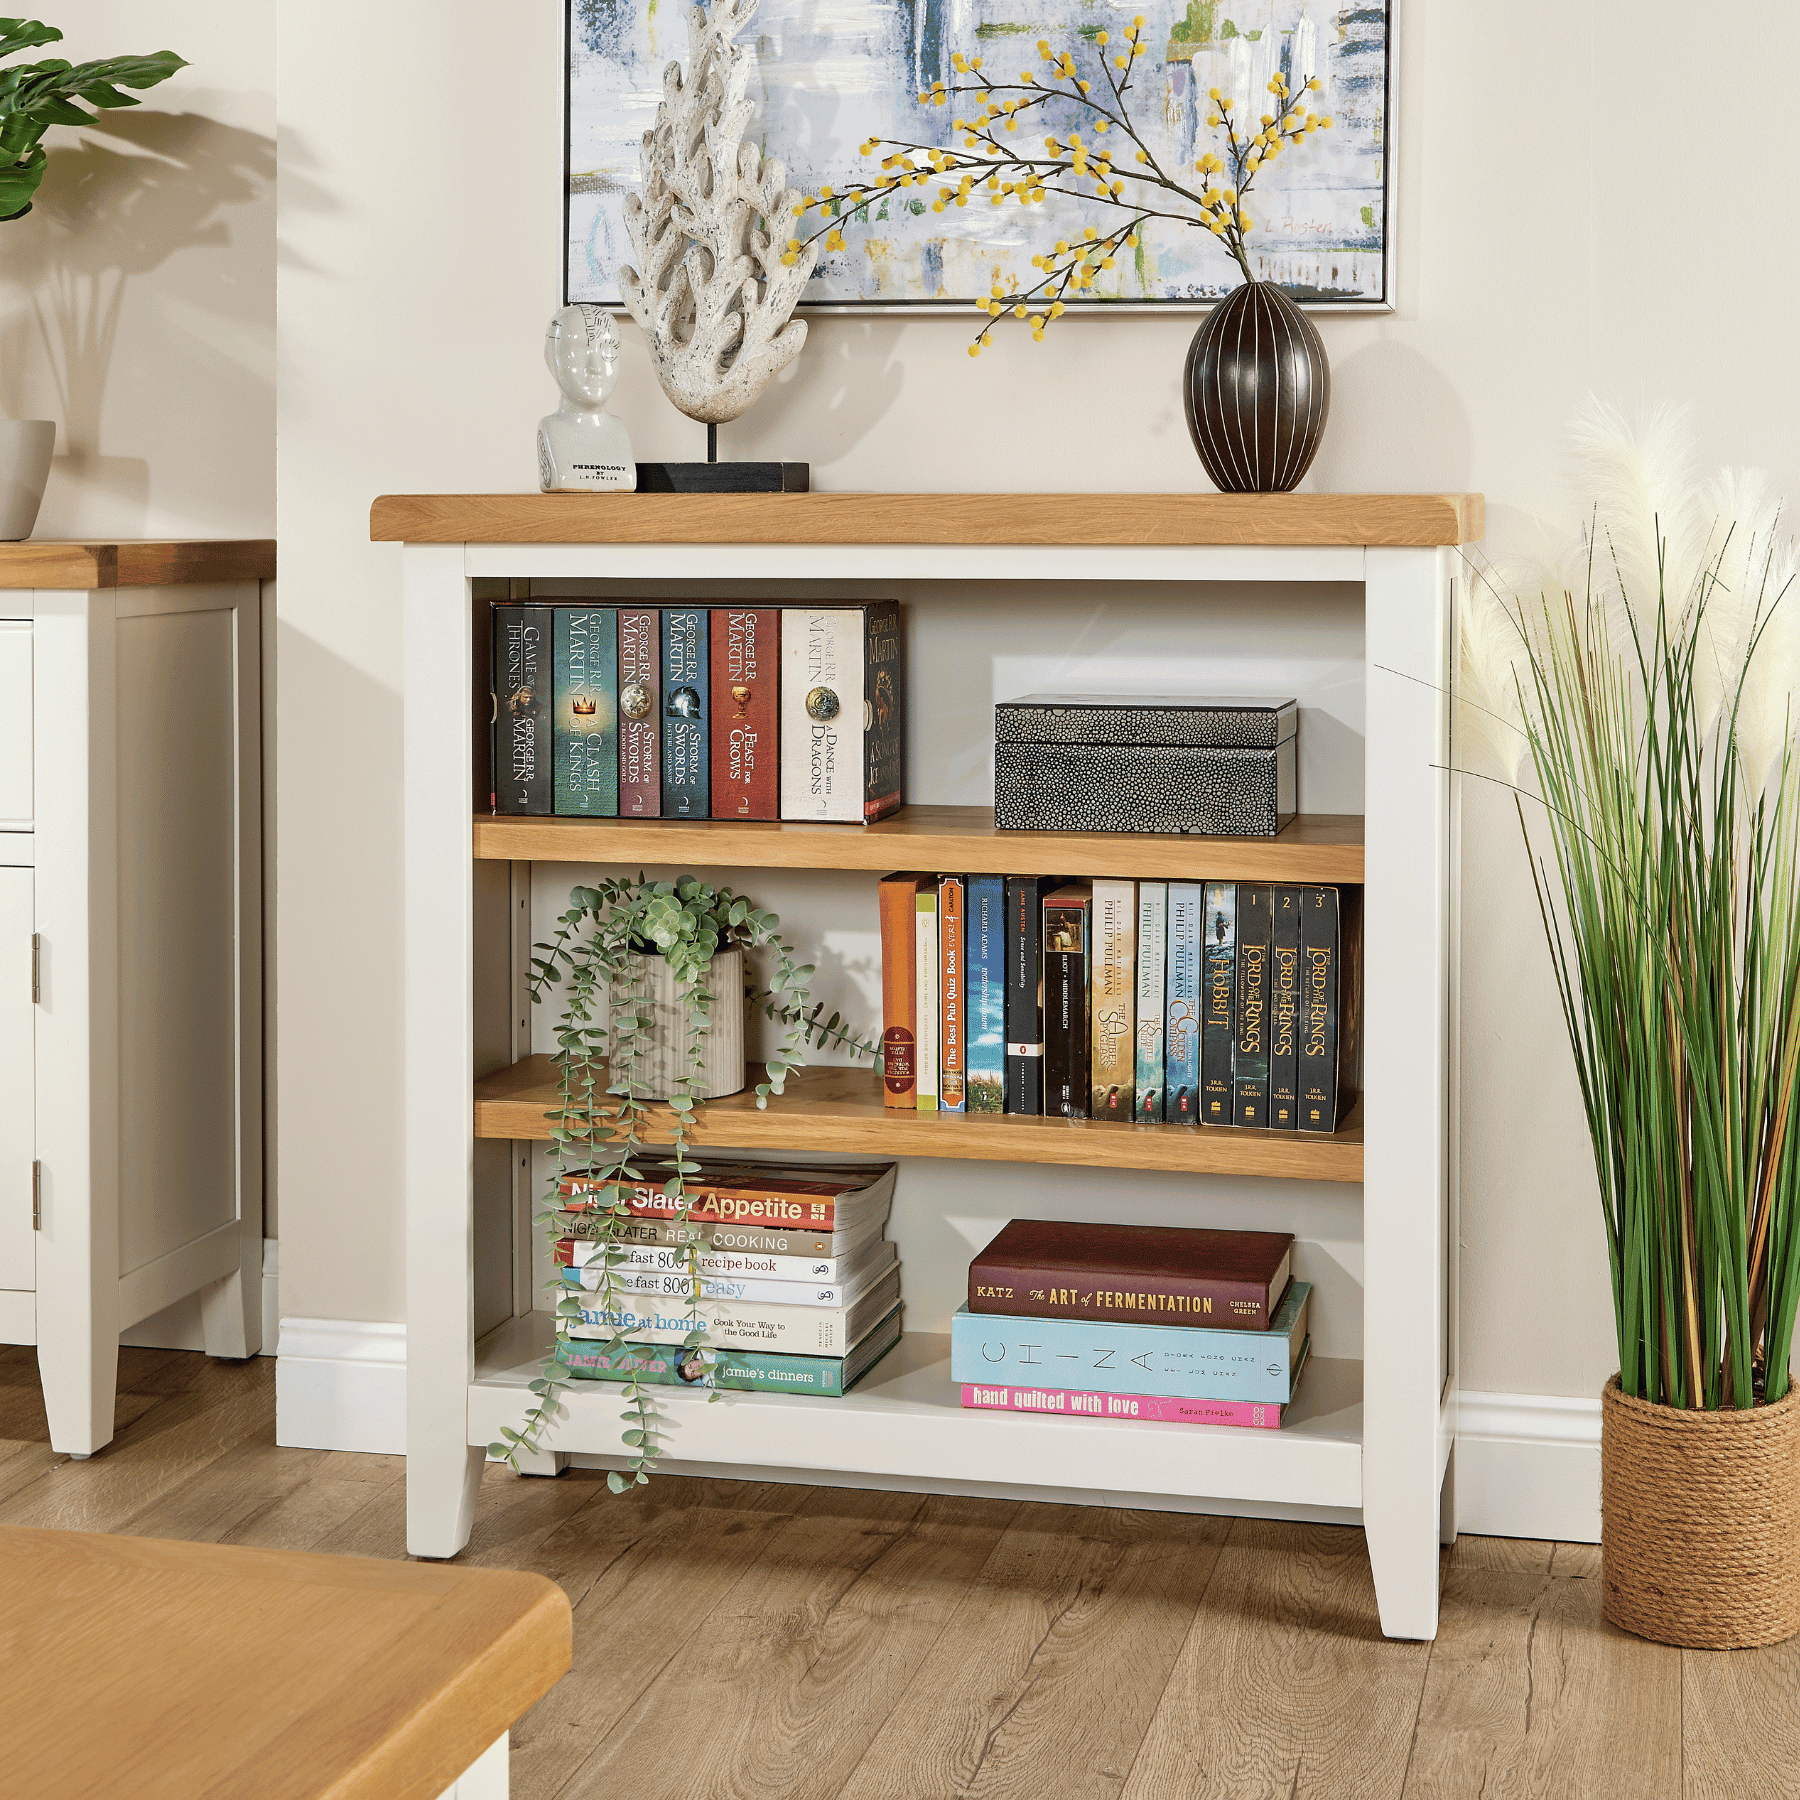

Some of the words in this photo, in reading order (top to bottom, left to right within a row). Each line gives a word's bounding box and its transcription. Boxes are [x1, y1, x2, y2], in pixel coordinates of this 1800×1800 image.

[572, 464, 626, 472] PHRENOLOGY
[524, 627, 540, 673] GAME
[569, 614, 588, 696] MARTIN
[589, 613, 602, 667] GEORGE
[623, 615, 639, 684] MARTIN
[639, 615, 651, 661] GEORGE
[670, 613, 686, 683] MARTIN
[686, 614, 698, 659] GEORGE
[728, 612, 745, 682] MARTIN
[745, 613, 758, 659] GEORGE
[809, 616, 825, 683] MARTIN
[826, 615, 837, 660] GEORGE
[869, 637, 899, 665] MARTIN
[507, 622, 522, 690] THRONES
[526, 718, 535, 763] GEORGE
[569, 717, 581, 737] OF
[586, 718, 599, 727] A
[513, 717, 527, 782] MARTIN
[569, 742, 584, 792] KINGS
[587, 733, 603, 792] CLASH
[629, 722, 643, 784] SWORDS
[643, 732, 655, 772] STORM
[675, 723, 689, 785] SWORDS
[690, 733, 701, 773] STORM
[730, 730, 745, 780] CROWS
[745, 733, 758, 770] FEAST
[811, 725, 826, 795] DRAGONS
[826, 734, 838, 774] DANCE
[643, 775, 650, 784] OF
[690, 776, 696, 785] OF
[1105, 900, 1113, 938] PHILIP
[1283, 897, 1291, 909] 2
[1316, 897, 1323, 908] 3
[1143, 903, 1152, 941] PHILIP
[1176, 903, 1185, 941] PHILIP
[947, 949, 956, 975] Book
[1019, 963, 1027, 989] Sensibility
[1104, 942, 1113, 996] PULLMAN
[1142, 945, 1151, 999] PULLMAN
[1175, 945, 1185, 999] PULLMAN
[1242, 943, 1266, 987] LORD
[1276, 946, 1298, 990] LORD
[1307, 946, 1331, 990] LORD
[947, 978, 958, 1000] Quiz
[982, 968, 990, 1006] watership
[1207, 958, 1230, 1030] HOBBIT
[1254, 987, 1260, 999] OF
[1286, 991, 1292, 1002] OF
[1319, 991, 1325, 1002] OF
[947, 1003, 957, 1022] Pub
[982, 1008, 990, 1030] down
[1188, 999, 1196, 1016] THE
[1240, 1000, 1263, 1053] RINGS
[947, 1025, 957, 1046] Best
[1098, 1010, 1118, 1067] SPYGLASS
[1108, 1020, 1129, 1072] AMBER
[1138, 1018, 1156, 1047] KNIFE
[1147, 1027, 1162, 1061] SUBTLE
[1170, 1000, 1189, 1057] COMPASS
[1177, 1016, 1199, 1062] GOLDEN
[1274, 1003, 1295, 1056] RINGS
[1305, 1003, 1328, 1056] RINGS
[947, 1048, 957, 1067] The
[702, 1193, 803, 1220] Appetite
[713, 1233, 788, 1251] COOKING
[630, 1251, 655, 1264] fast
[702, 1257, 743, 1271] recipe
[745, 1258, 777, 1272] book
[636, 1276, 660, 1289] fast
[663, 1277, 690, 1295] 800
[706, 1282, 747, 1299] easy
[977, 1286, 1014, 1299] KATZ
[1030, 1290, 1045, 1301] The
[1050, 1288, 1078, 1305] ART
[1081, 1293, 1093, 1307] of
[1097, 1291, 1212, 1314] FERMENTATION
[1230, 1301, 1261, 1309] CHELSEA
[638, 1317, 653, 1329] at
[655, 1314, 707, 1332] home
[714, 1319, 734, 1327] Cook
[736, 1320, 756, 1329] Your
[758, 1322, 776, 1331] Way
[739, 1329, 760, 1338] Good
[762, 1331, 778, 1339] Life
[566, 1354, 611, 1369] JAMIE
[722, 1366, 765, 1379] jamie's
[768, 1370, 814, 1383] dinners
[982, 1342, 1154, 1372] CHINA
[973, 1387, 1008, 1406] hand
[1014, 1391, 1065, 1410] quilted
[1071, 1394, 1102, 1413] with
[1108, 1397, 1139, 1416] love
[1180, 1408, 1203, 1416] Sarah
